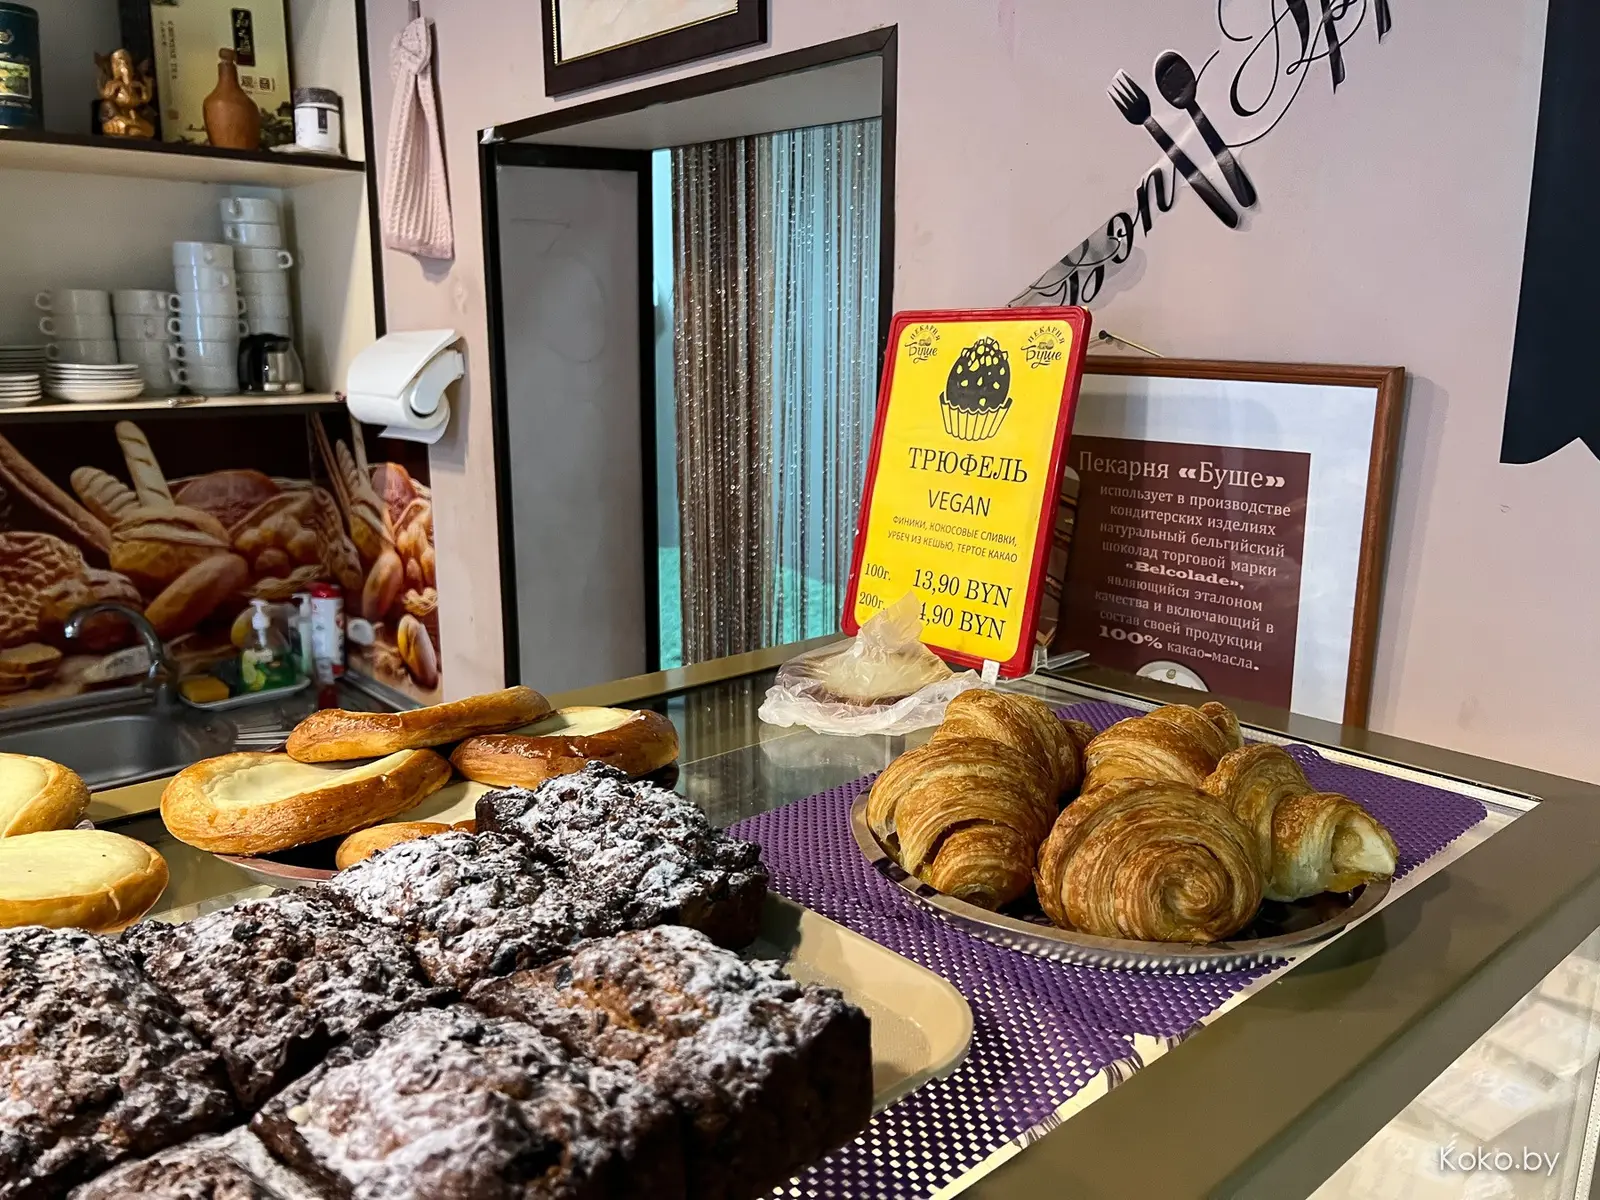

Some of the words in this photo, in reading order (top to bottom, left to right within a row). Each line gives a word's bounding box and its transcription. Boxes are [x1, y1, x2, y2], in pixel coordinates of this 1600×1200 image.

[904, 342, 938, 364] Буше
[1021, 345, 1062, 369] Буше
[908, 446, 1028, 483] ТРЮФЕЛЬ
[1079, 450, 1169, 481] Пекарня
[1178, 461, 1286, 490] «Буше»
[928, 489, 991, 517] VEGAN
[1100, 485, 1174, 504] использует
[1177, 494, 1185, 504] в
[1189, 495, 1291, 517] производстве
[892, 516, 928, 531] ФИНИКИ,
[930, 522, 979, 539] КОКОСОВЫЕ
[980, 531, 1017, 546] СЛИВКИ,
[1110, 504, 1203, 527] кондитерских
[1207, 517, 1277, 536] изделиях
[887, 530, 910, 542] УРБЕЧ
[912, 534, 922, 544] ИЗ
[923, 537, 955, 552] КЕШЬЮ,
[957, 543, 986, 557] ТЕРТОЕ
[988, 550, 1018, 563] КАКАО
[1100, 522, 1187, 544] натуральный
[1190, 532, 1285, 558] бельгийский
[1102, 540, 1158, 560] шоколад
[1162, 549, 1226, 569] торговой
[1230, 558, 1277, 579] марки
[1125, 561, 1245, 591] «Belcolade»,
[865, 563, 892, 581] 100г.
[912, 569, 960, 596] 13,90
[964, 579, 1013, 609] BYN
[1106, 575, 1190, 599] являющийся
[1194, 590, 1263, 612] эталоном
[859, 592, 887, 611] 200г.
[918, 602, 954, 628] 4,90
[958, 610, 1006, 641] BYN
[1094, 589, 1149, 609] качества
[1153, 602, 1162, 612] и
[1166, 604, 1260, 632] включающий
[1266, 623, 1275, 634] в
[1099, 625, 1163, 650] 100%
[1167, 641, 1260, 671] какао-масла.
[1100, 609, 1140, 626] состав
[1143, 616, 1181, 635] своей
[1185, 626, 1263, 652] продукции
